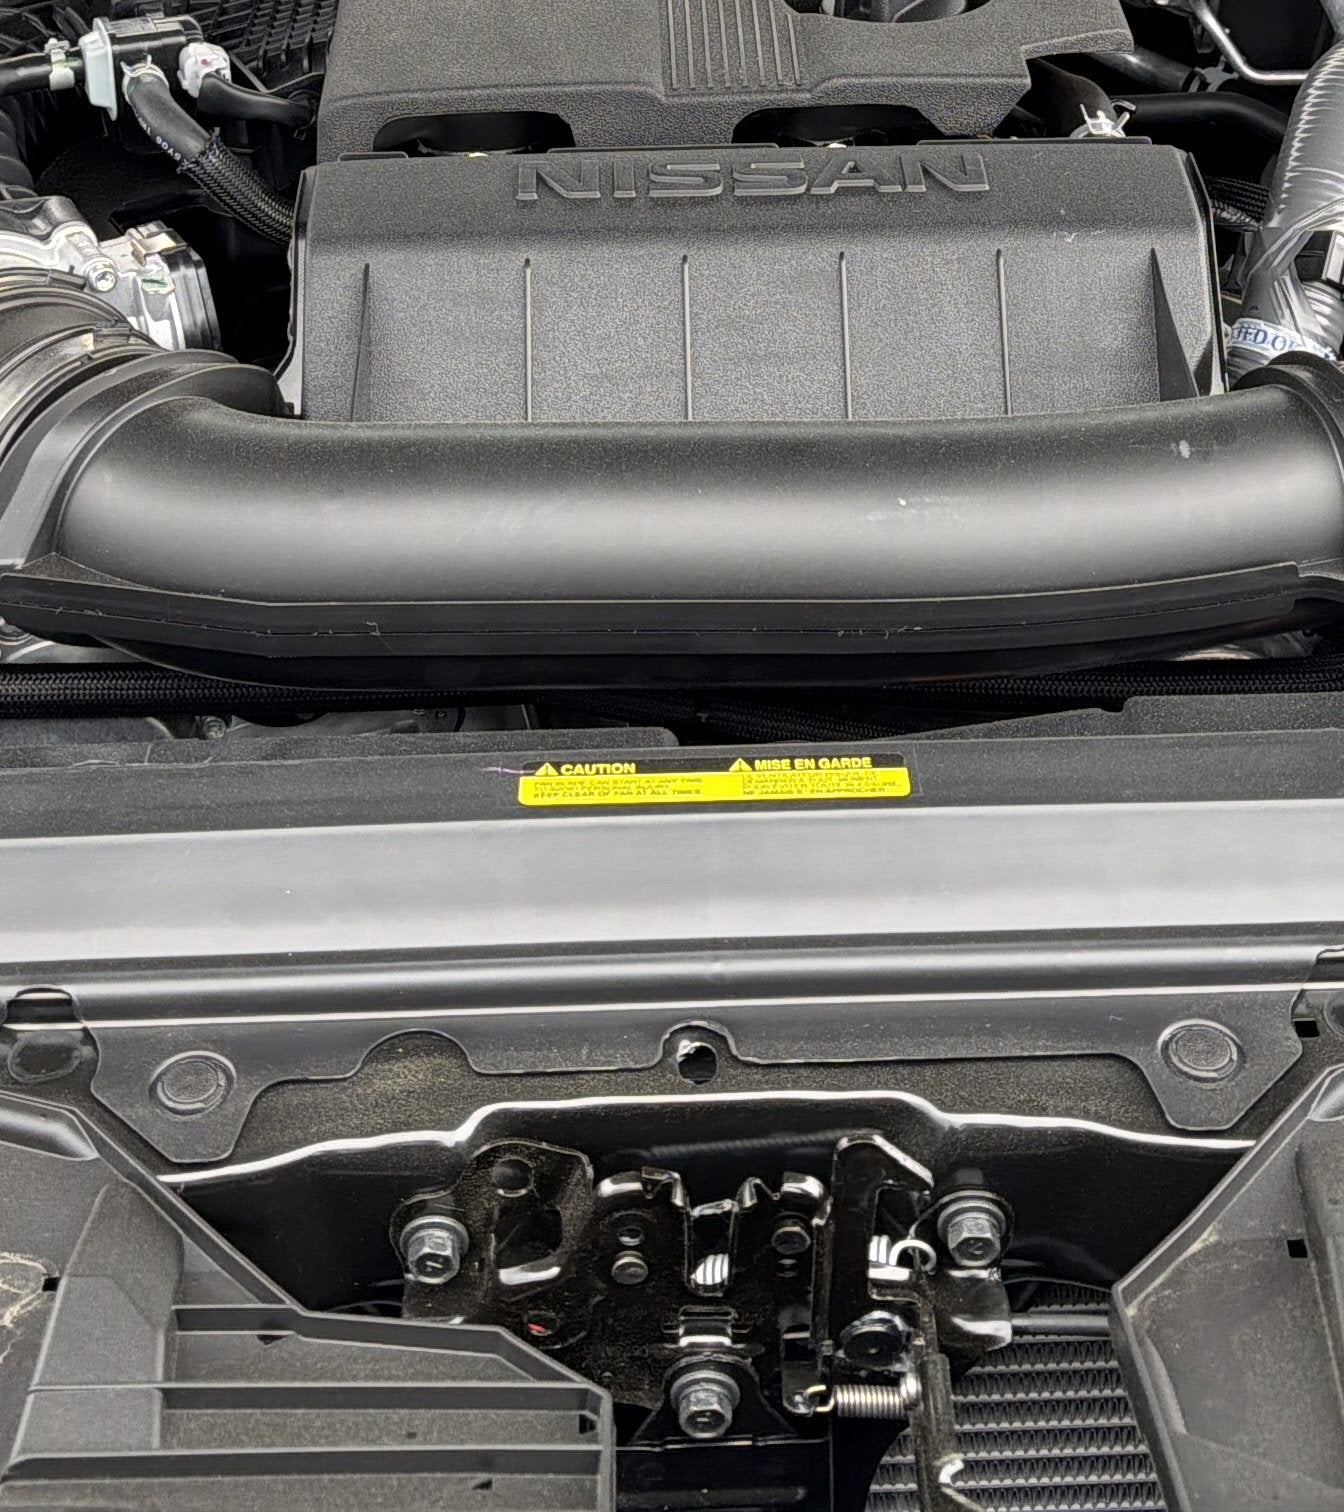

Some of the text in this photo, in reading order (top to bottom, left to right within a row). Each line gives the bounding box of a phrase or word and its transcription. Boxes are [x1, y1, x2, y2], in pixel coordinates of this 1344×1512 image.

[515, 152, 991, 201] NISSAN
[560, 762, 637, 776] CAUTION
[754, 756, 873, 771] MISE EN GARDE
